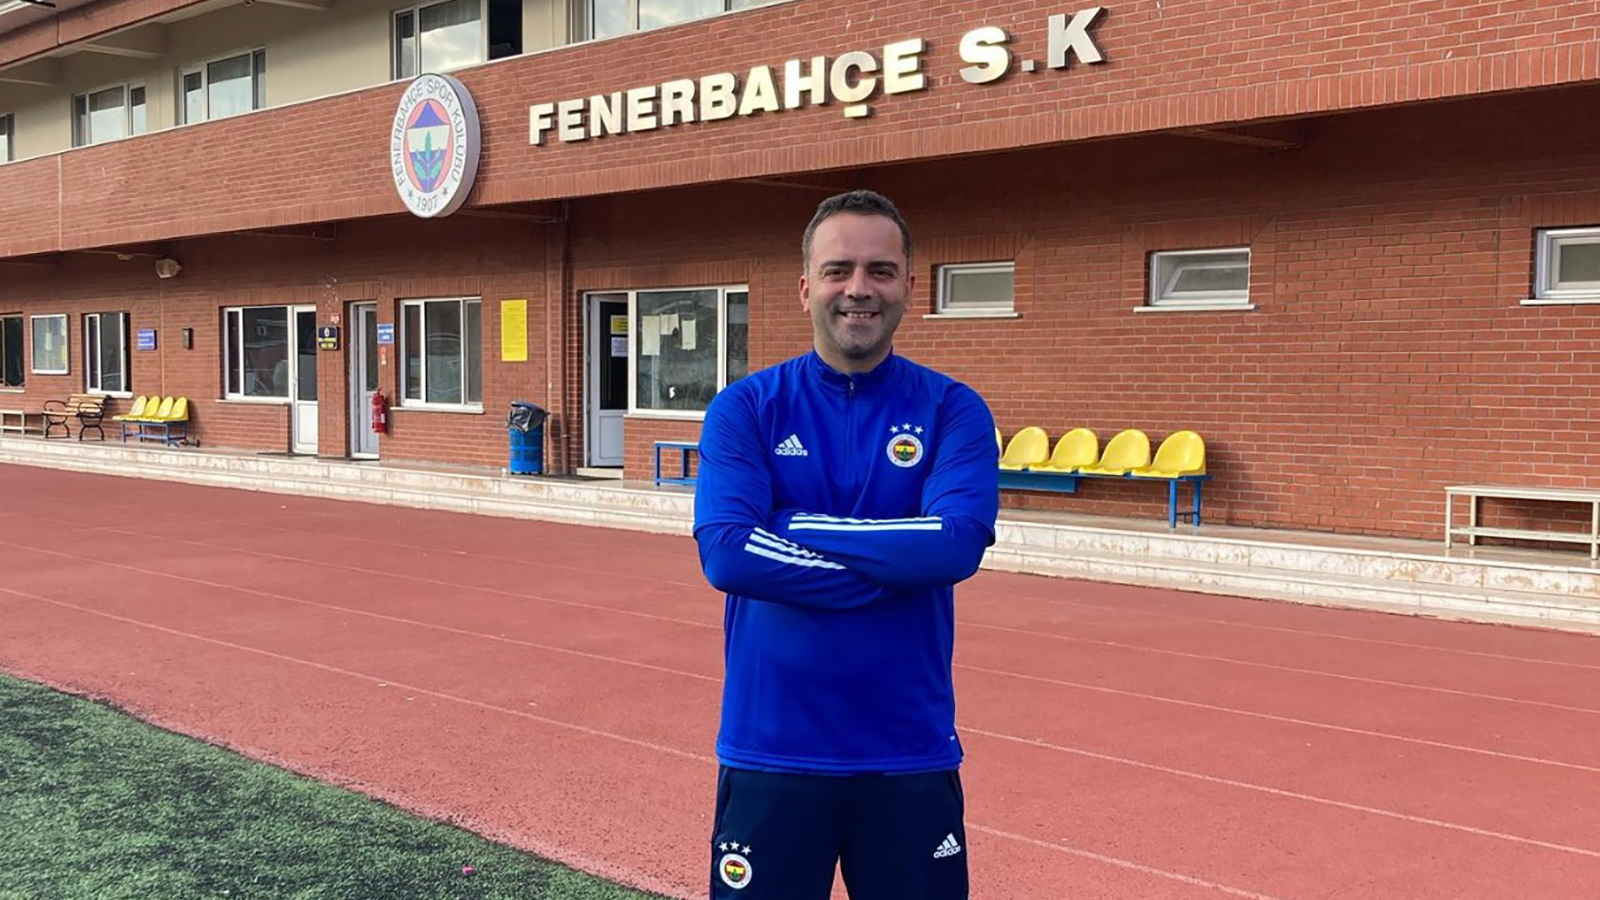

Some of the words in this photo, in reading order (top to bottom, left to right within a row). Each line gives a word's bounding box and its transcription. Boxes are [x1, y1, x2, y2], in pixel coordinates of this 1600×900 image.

[530, 38, 926, 145] FENERBAHÇE
[959, 6, 1106, 84] S.K
[426, 79, 453, 107] SPOR
[417, 195, 438, 212] 1907
[774, 447, 808, 456] adidas
